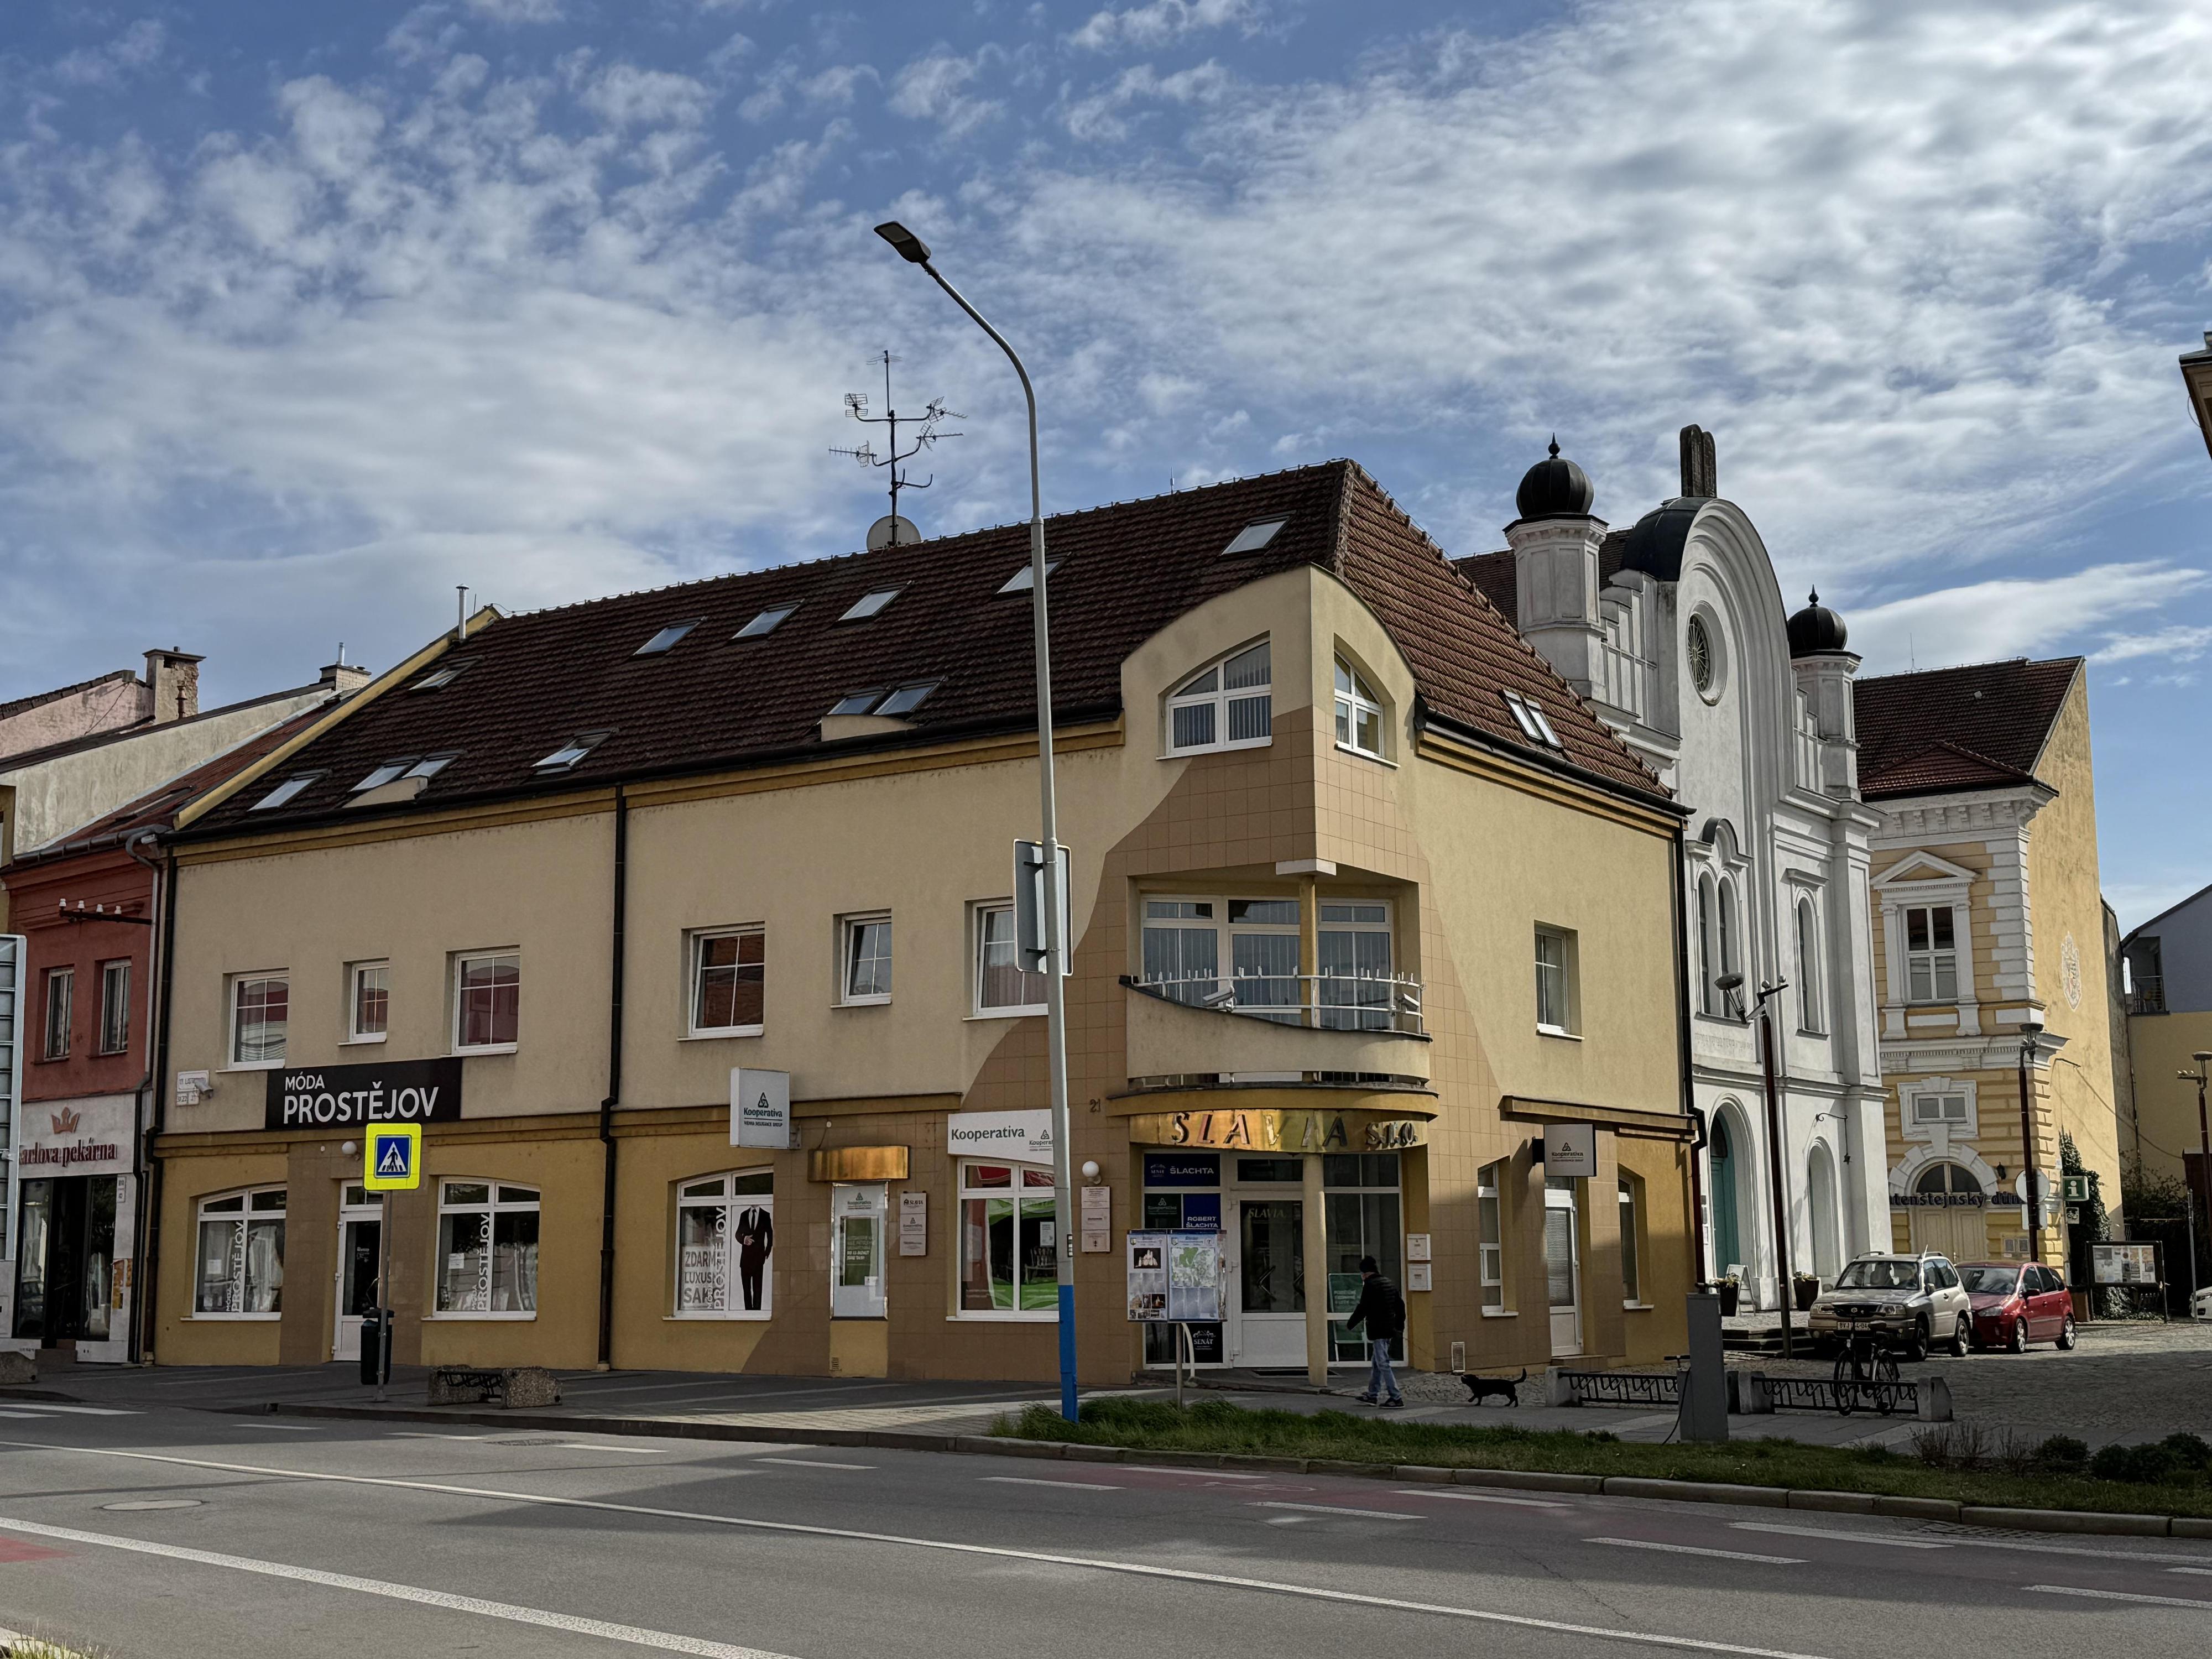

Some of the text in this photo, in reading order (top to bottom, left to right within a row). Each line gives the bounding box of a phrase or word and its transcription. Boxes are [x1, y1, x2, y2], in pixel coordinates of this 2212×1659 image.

[285, 1071, 325, 1091] MÓDA
[283, 1081, 439, 1124] PROSTĚJOV
[744, 1107, 782, 1118] Kooperativa
[1089, 1099, 1100, 1113] 21
[951, 1125, 1025, 1142] Kooperativa
[1171, 1112, 1348, 1147] SLAVIA
[19, 1137, 117, 1167] arlova pekárna
[1170, 1166, 1214, 1174] ŠLACHTA
[1890, 1192, 1985, 1208] tenštejnský
[231, 1221, 244, 1312] PROSTĚJOV
[476, 1213, 490, 1311] PROSTĚJOV
[713, 1207, 726, 1310] PROSTĚJOV
[684, 1286, 722, 1304] SAK
